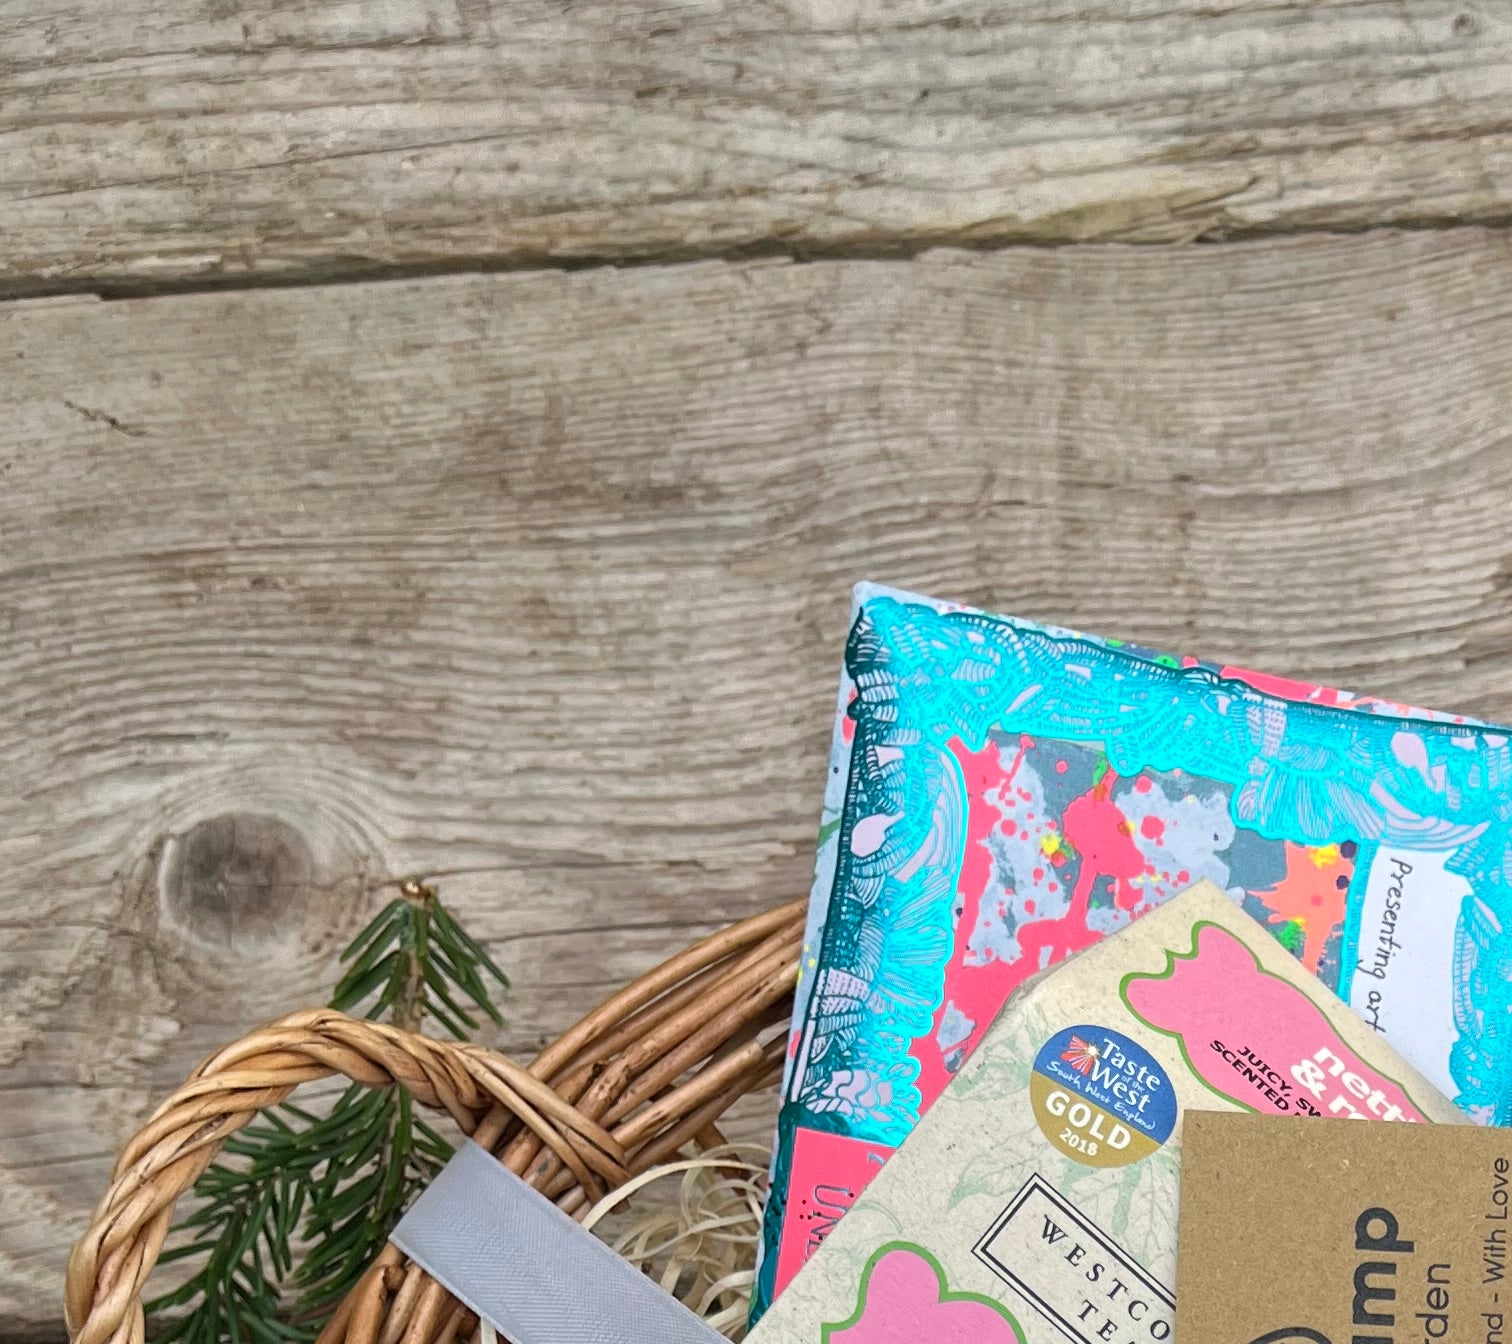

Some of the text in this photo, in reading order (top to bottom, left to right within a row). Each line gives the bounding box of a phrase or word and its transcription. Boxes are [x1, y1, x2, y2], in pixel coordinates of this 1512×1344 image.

[1091, 1059, 1151, 1113] West
[1100, 1038, 1161, 1092] Taste
[1209, 1040, 1289, 1111] SCENTED
[1237, 1046, 1293, 1098] JUICY,
[1290, 1059, 1327, 1101] &
[1046, 1061, 1156, 1130] South West England
[1046, 1090, 1131, 1150] GOLD
[1059, 1128, 1098, 1156] 2018
[1485, 1157, 1509, 1219] Love
[1481, 1224, 1505, 1284] With
